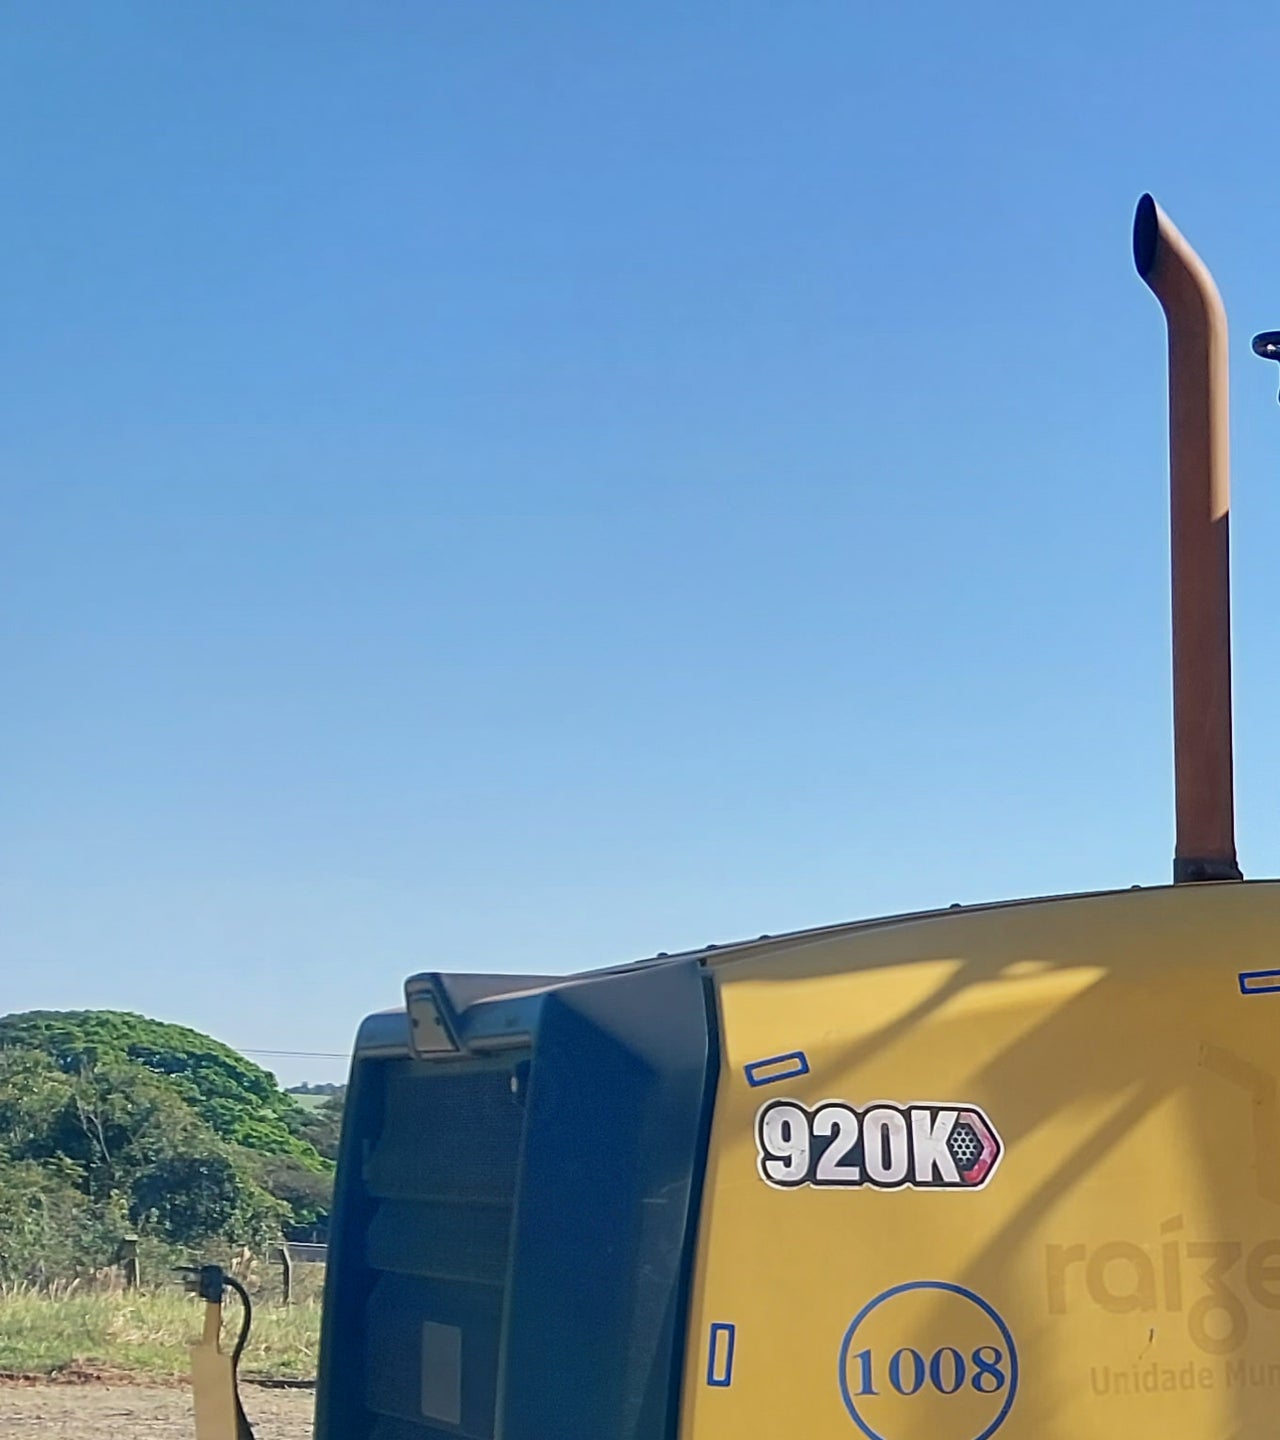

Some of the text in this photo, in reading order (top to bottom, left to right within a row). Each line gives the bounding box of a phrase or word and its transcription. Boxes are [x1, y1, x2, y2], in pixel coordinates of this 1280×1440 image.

[762, 1105, 961, 1183] 920K
[852, 1345, 1006, 1396] 1008
[1090, 1361, 1214, 1396] Unidade
